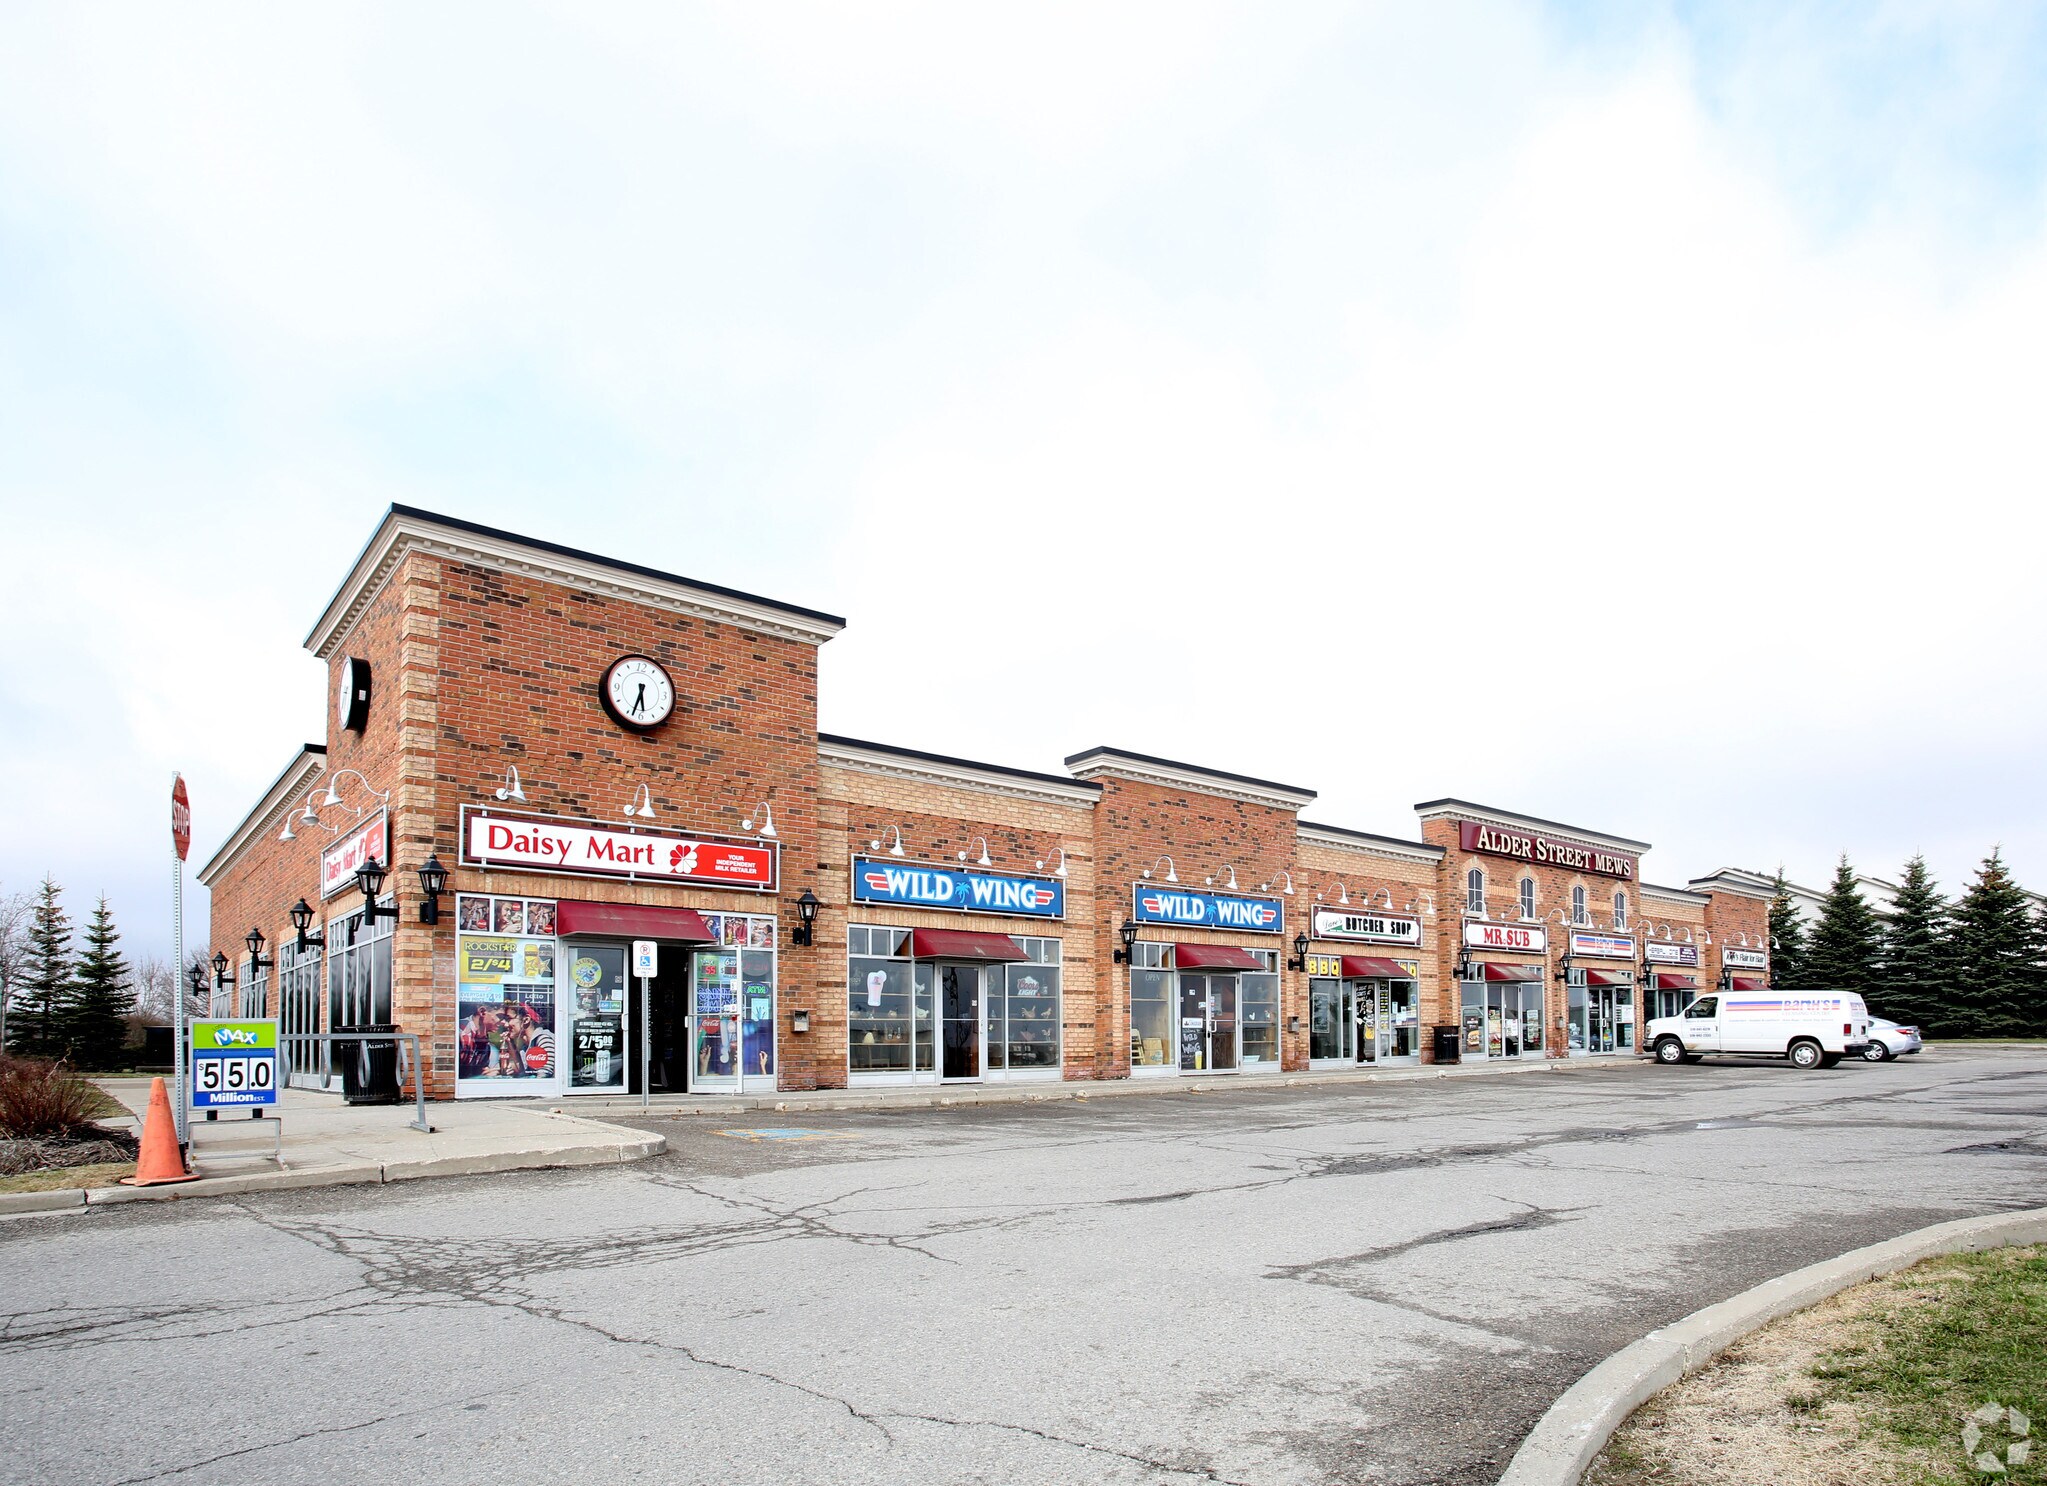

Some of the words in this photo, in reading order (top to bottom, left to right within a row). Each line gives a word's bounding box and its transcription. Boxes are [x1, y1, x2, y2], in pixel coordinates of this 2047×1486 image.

[636, 663, 647, 672] 12
[614, 683, 620, 692] 9
[661, 692, 667, 700] 3
[638, 712, 644, 720] 6
[173, 799, 189, 837] STOP
[488, 825, 572, 864] Daisy
[587, 836, 654, 865] Mart
[1477, 826, 1532, 858] ALDER
[1536, 838, 1592, 869] STREET
[1595, 853, 1631, 876] MEWS
[716, 859, 756, 868] INDEPENDENT
[883, 869, 953, 900] WILD
[969, 878, 1037, 909] WING
[1155, 894, 1205, 920] WILD
[1216, 901, 1264, 925] WING
[1346, 917, 1384, 933] BUTCHER
[1391, 921, 1411, 935] SHOP
[470, 958, 511, 971] 2/$4
[1309, 961, 1339, 976] BBQ
[1017, 979, 1040, 990] Coors
[526, 1053, 547, 1061] Coca-Cola
[210, 1092, 254, 1103] Million
